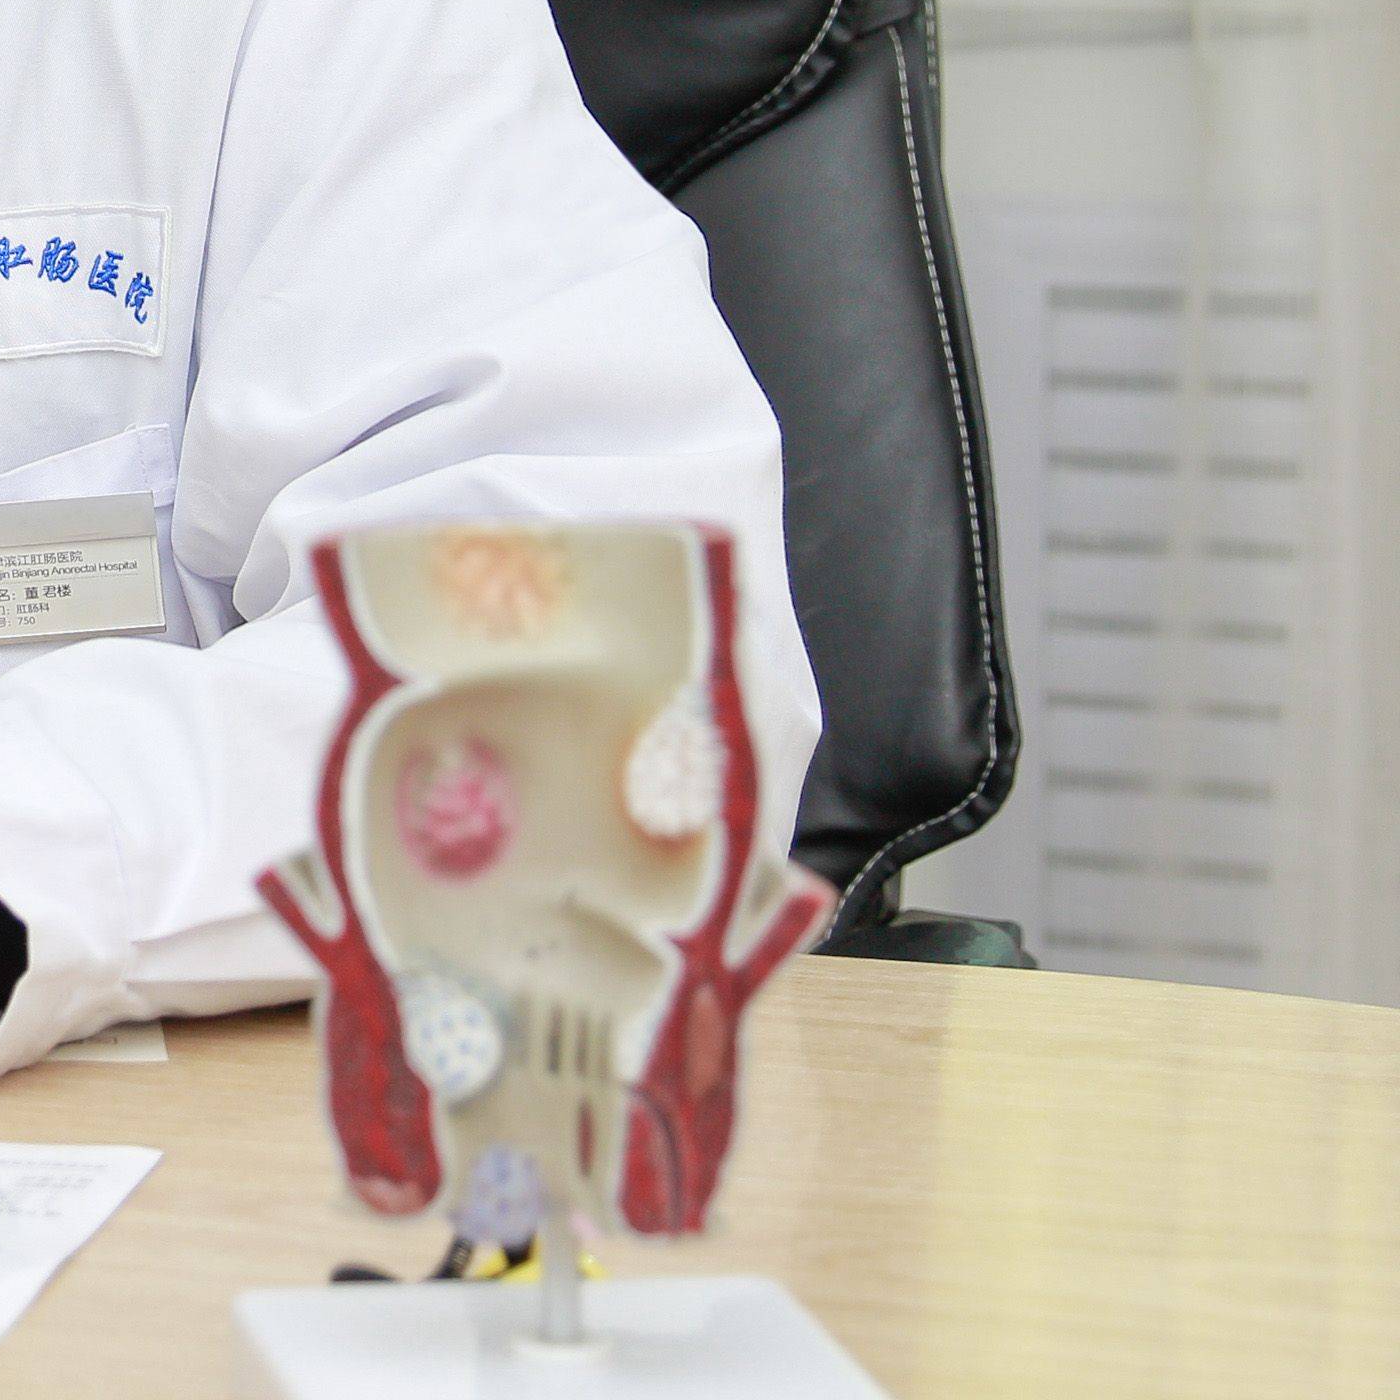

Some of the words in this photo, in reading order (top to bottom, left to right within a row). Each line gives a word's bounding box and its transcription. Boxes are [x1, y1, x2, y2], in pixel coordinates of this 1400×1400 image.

[12, 568, 50, 579] Binjiang
[51, 563, 97, 575] Anorectal
[99, 560, 138, 572] Hospital
